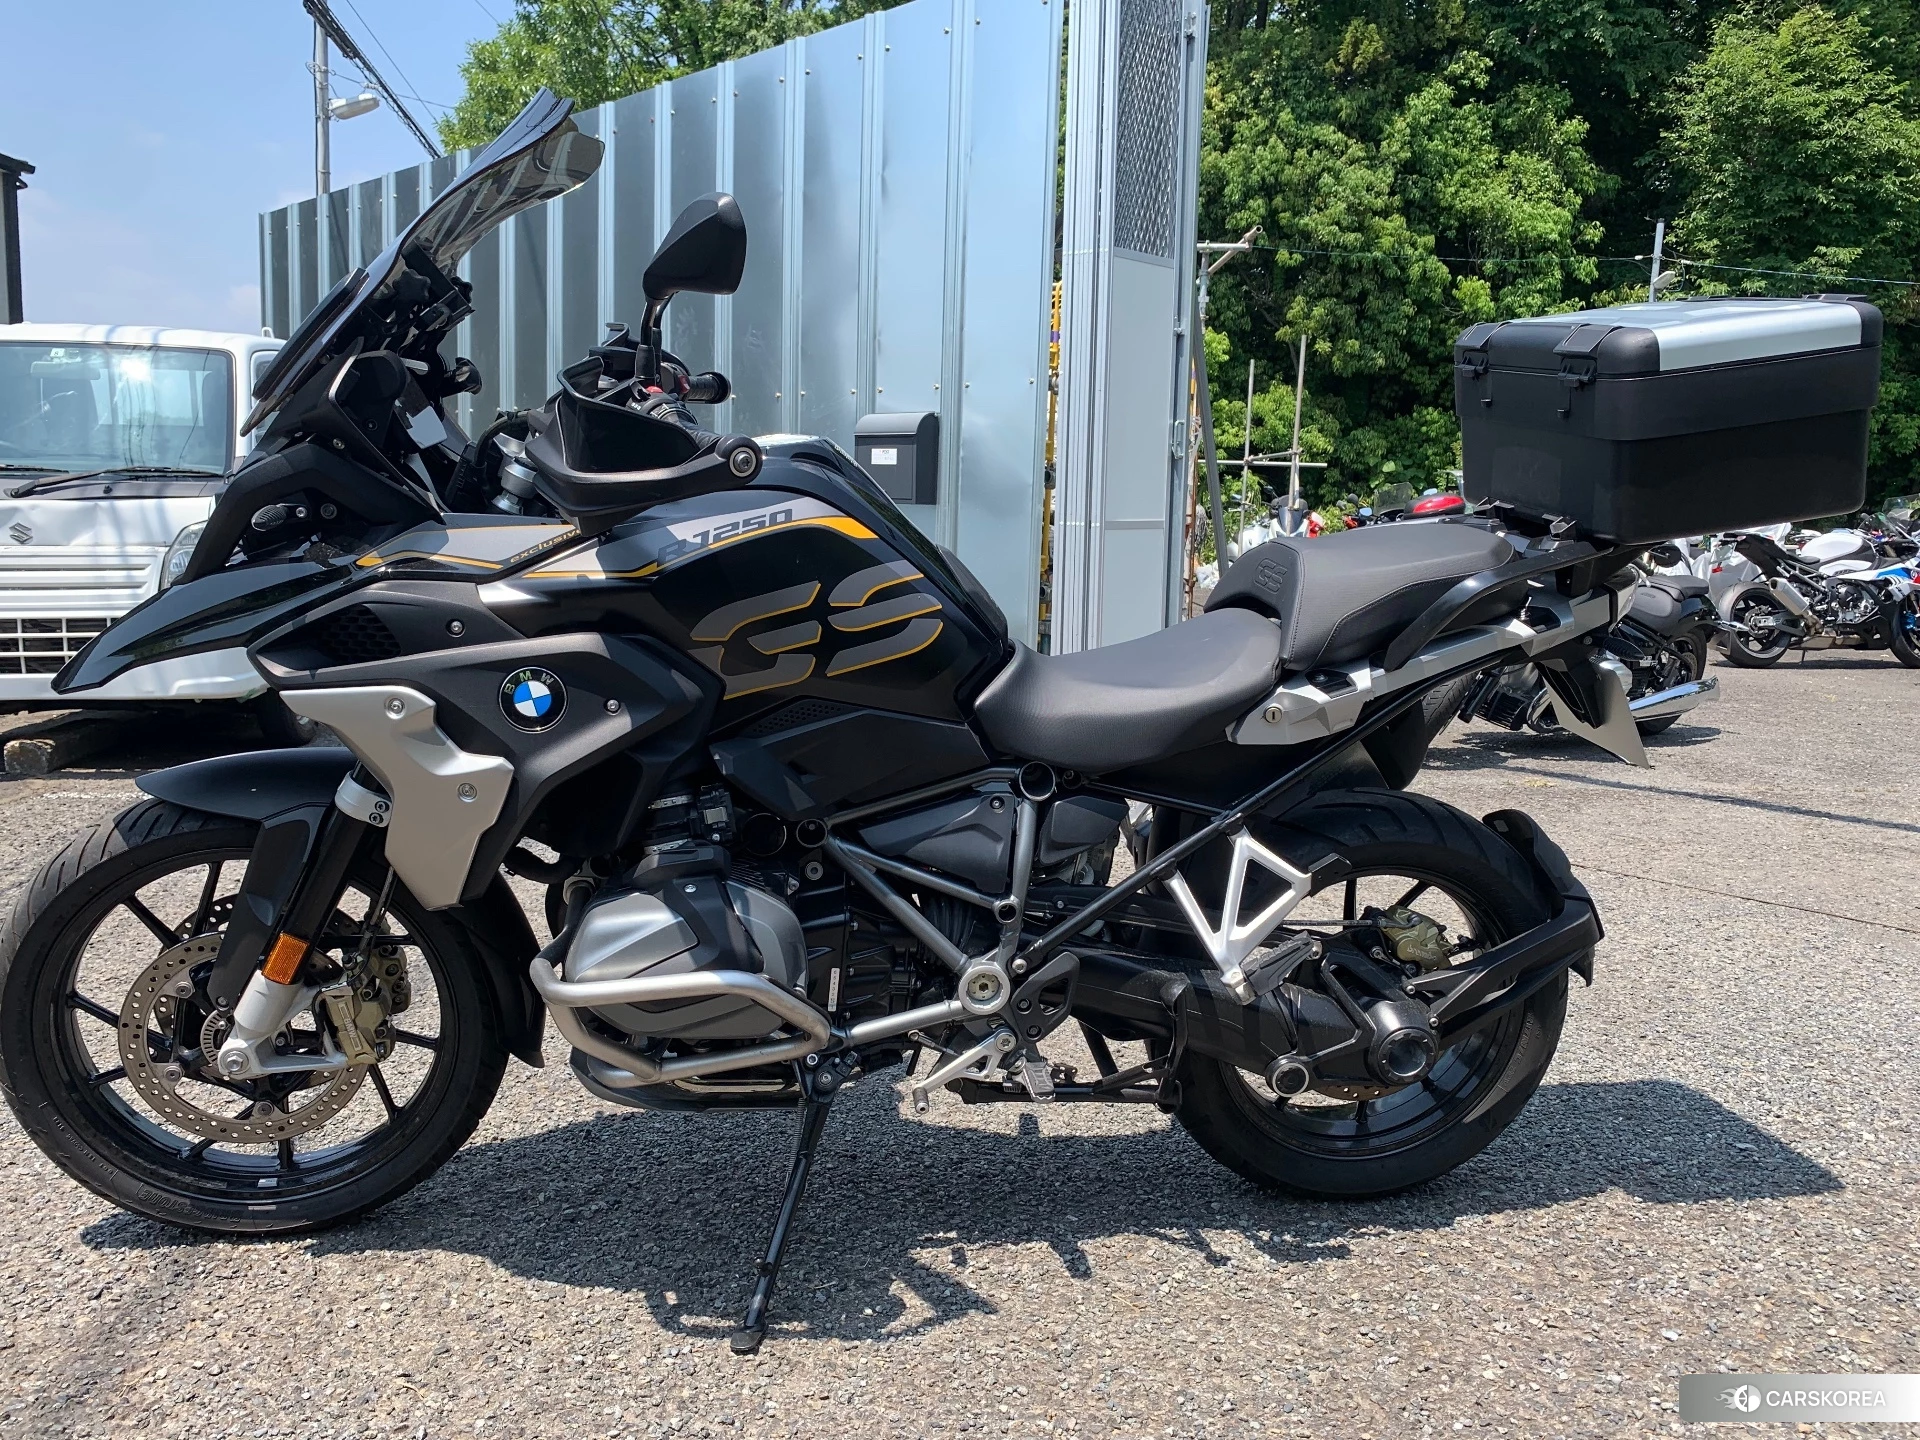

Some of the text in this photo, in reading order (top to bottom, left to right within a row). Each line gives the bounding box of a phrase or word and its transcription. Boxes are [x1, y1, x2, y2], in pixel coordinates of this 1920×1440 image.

[657, 508, 793, 567] R 1250
[688, 559, 944, 701] GS
[503, 670, 555, 695] BMW
